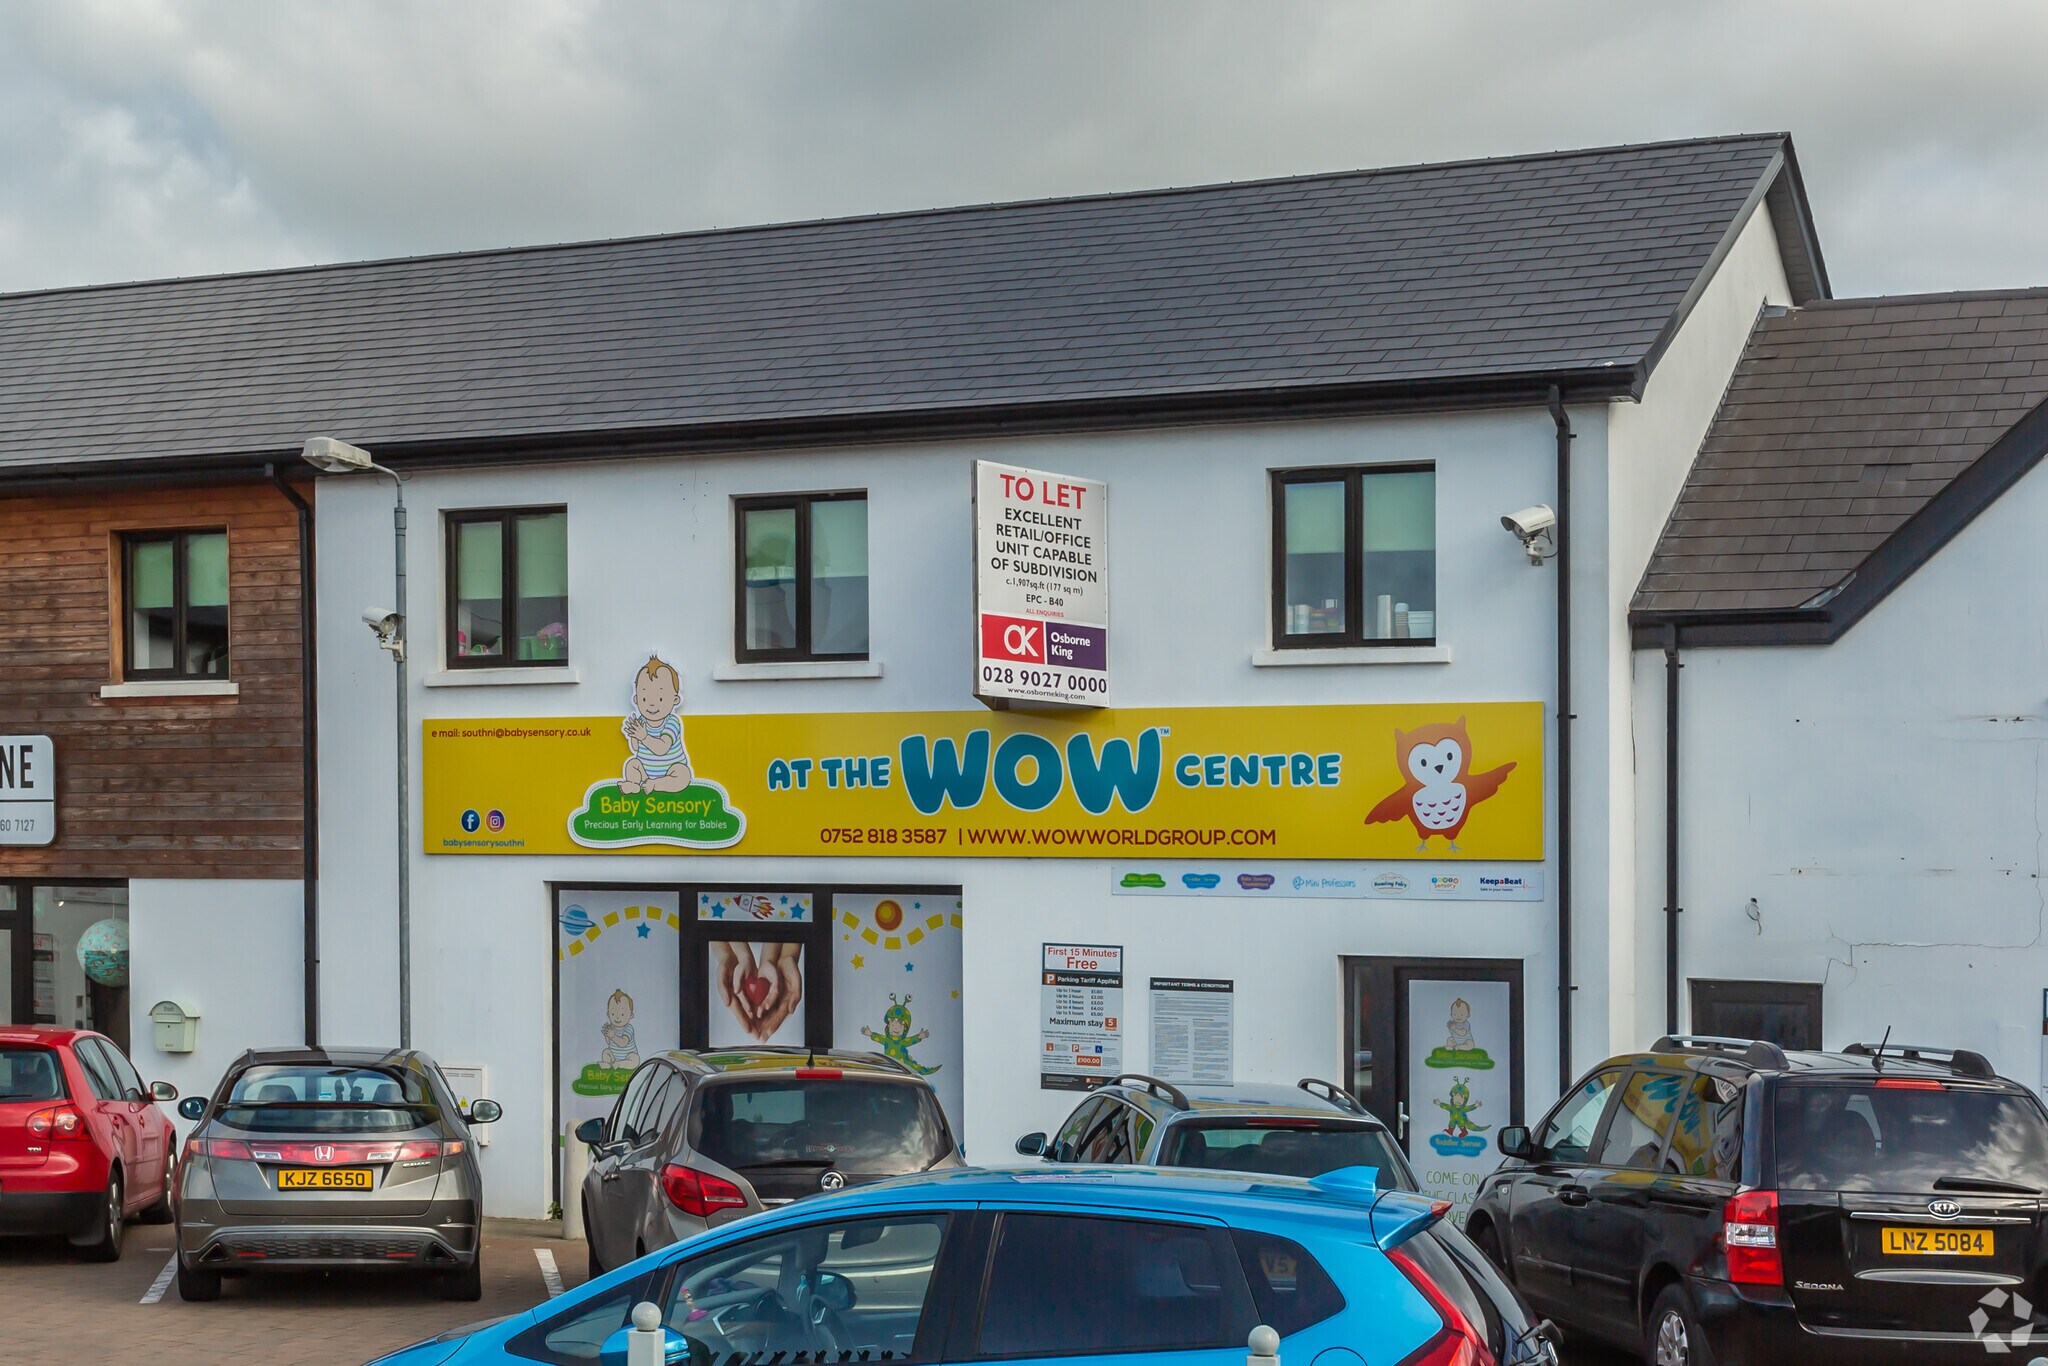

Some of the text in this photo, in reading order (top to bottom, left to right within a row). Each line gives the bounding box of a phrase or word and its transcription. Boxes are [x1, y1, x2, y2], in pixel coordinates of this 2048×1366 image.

[1000, 474, 1086, 509] TO LET
[1005, 508, 1082, 530] EXCELLENT
[997, 524, 1091, 548] RETAIL/OFFICE
[996, 541, 1092, 565] UNIT CAPABLE
[991, 557, 1097, 583] OF SUBDIVISION
[1046, 582, 1061, 593] (177
[1063, 586, 1071, 595] sq
[1073, 587, 1083, 597] m)
[1026, 594, 1042, 604] EPC
[1049, 597, 1064, 607] B40
[1036, 609, 1064, 618] ENQUIRIES
[1051, 632, 1090, 647] Osborne
[1051, 644, 1073, 660] King
[983, 666, 1107, 693] 028 9027 0000
[1007, 687, 1085, 700] www.osborneking.com
[462, 727, 592, 739] southni@babysensory.co.uk
[768, 757, 813, 791] AT
[820, 756, 891, 789] THE
[899, 727, 1162, 816] WOW
[1175, 752, 1342, 788] CENTRE
[600, 796, 712, 817] Baby Sensory
[15, 819, 35, 832] 7127
[584, 819, 728, 831] Precious Early Learning for Babies
[443, 838, 525, 848] babysensorysouthni
[820, 828, 863, 844] 0752
[867, 828, 898, 844] 818
[901, 828, 947, 844] 3587
[967, 829, 1276, 845] WWW.WOWWORLDGROUP.COM
[1306, 878, 1356, 889] Mini Professors
[1480, 877, 1522, 886] KeepaBeat
[1048, 947, 1117, 958] First 15 Minutes
[1066, 957, 1098, 970] Free
[1057, 976, 1079, 985] Parking
[1049, 1018, 1114, 1028] Maximum stay 5
[587, 1070, 611, 1082] Baby
[285, 1172, 366, 1186] KJZ 6650
[1426, 1171, 1480, 1186] COME ON
[1933, 1203, 1956, 1213] KIA
[1890, 1232, 1984, 1252] LNZ 5084
[1794, 1280, 1844, 1291] SEDONA
